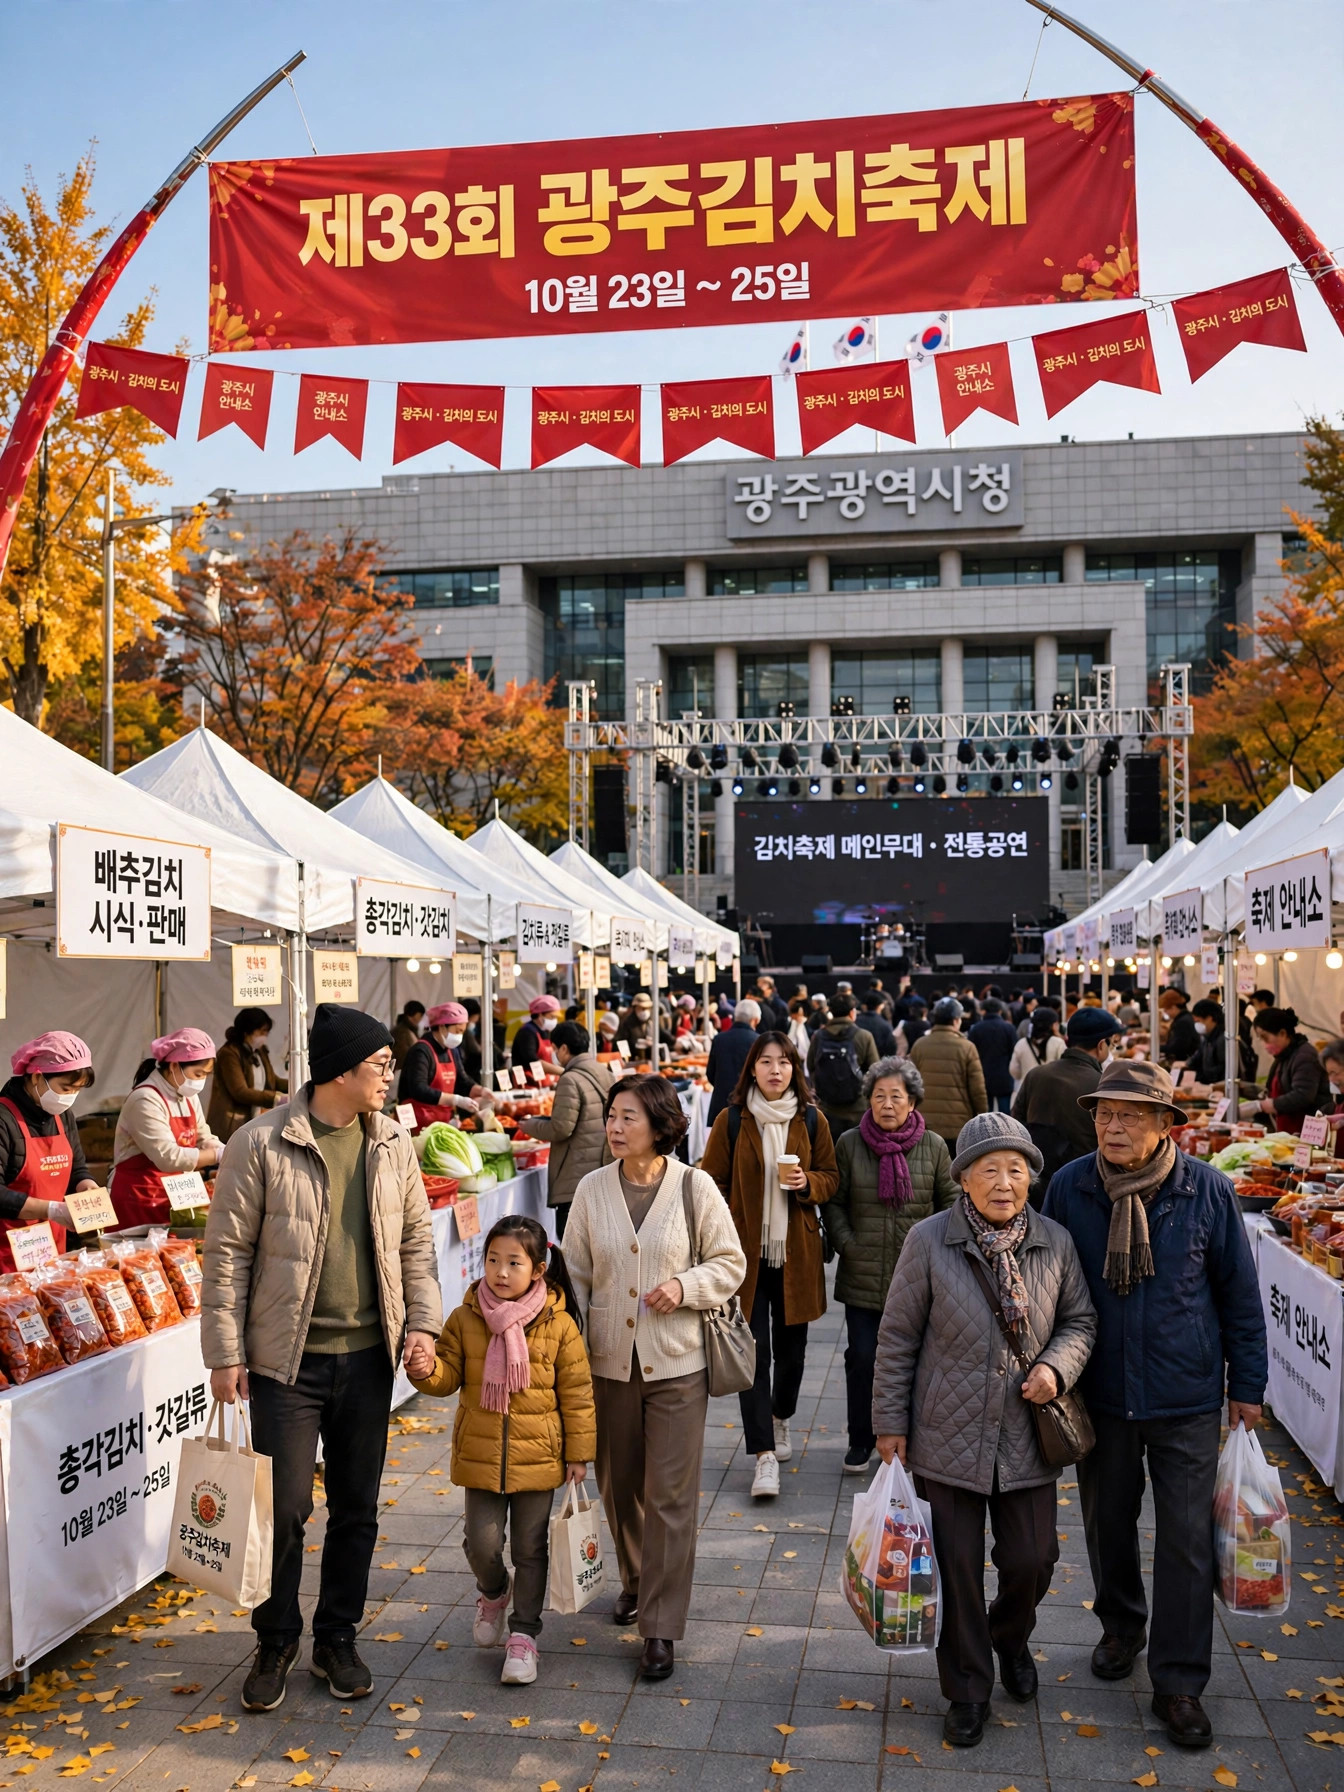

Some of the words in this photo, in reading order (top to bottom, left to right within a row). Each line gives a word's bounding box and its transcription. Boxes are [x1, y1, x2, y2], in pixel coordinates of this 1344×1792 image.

[298, 185, 515, 267] 제33회
[538, 137, 1027, 256] 광주김치축제
[525, 275, 598, 313] 10월
[608, 270, 685, 308] 23일
[697, 281, 721, 290] ~
[731, 262, 810, 301] 25일
[1184, 314, 1220, 336] 광주시
[1228, 301, 1264, 324] 김치의
[1265, 293, 1289, 312] 도시
[1042, 351, 1078, 373] 광주시
[1086, 342, 1121, 363] 김치의
[1123, 335, 1146, 353] 도시
[88, 365, 119, 384] 광주시
[128, 373, 158, 391] 김치의
[158, 378, 180, 395] 도시
[954, 361, 992, 380] 광주시
[220, 380, 255, 396] 광주시
[314, 390, 349, 405] 광주시
[803, 392, 837, 410] 광주시
[847, 387, 880, 405] 김치의
[882, 384, 905, 400] 도시
[956, 378, 995, 396] 안내소
[219, 396, 253, 411] 안내소
[313, 406, 348, 422] 안내소
[401, 406, 433, 422] 광주시
[443, 408, 474, 423] 김치의
[475, 409, 498, 424] 도시
[537, 410, 569, 425] 광주시
[579, 409, 611, 425] 김치의
[613, 409, 635, 424] 도시
[667, 405, 700, 422] 광주시
[710, 402, 743, 419] 김치의
[745, 400, 767, 415] 도시
[734, 463, 1010, 523] 광주광역시청
[755, 835, 835, 860] 김치축제
[842, 833, 922, 859] 메인무대
[944, 832, 1027, 857] 전통공연
[94, 850, 183, 900] 배추김치
[1252, 885, 1274, 933] 축제
[1280, 876, 1323, 929] 안내소
[89, 900, 186, 946] 시식·판매
[1271, 1284, 1290, 1338] 축제
[1295, 1305, 1330, 1370] 안내소
[62, 1506, 93, 1546] 10월
[98, 1487, 126, 1527] 23일
[144, 1462, 169, 1498] 25일
